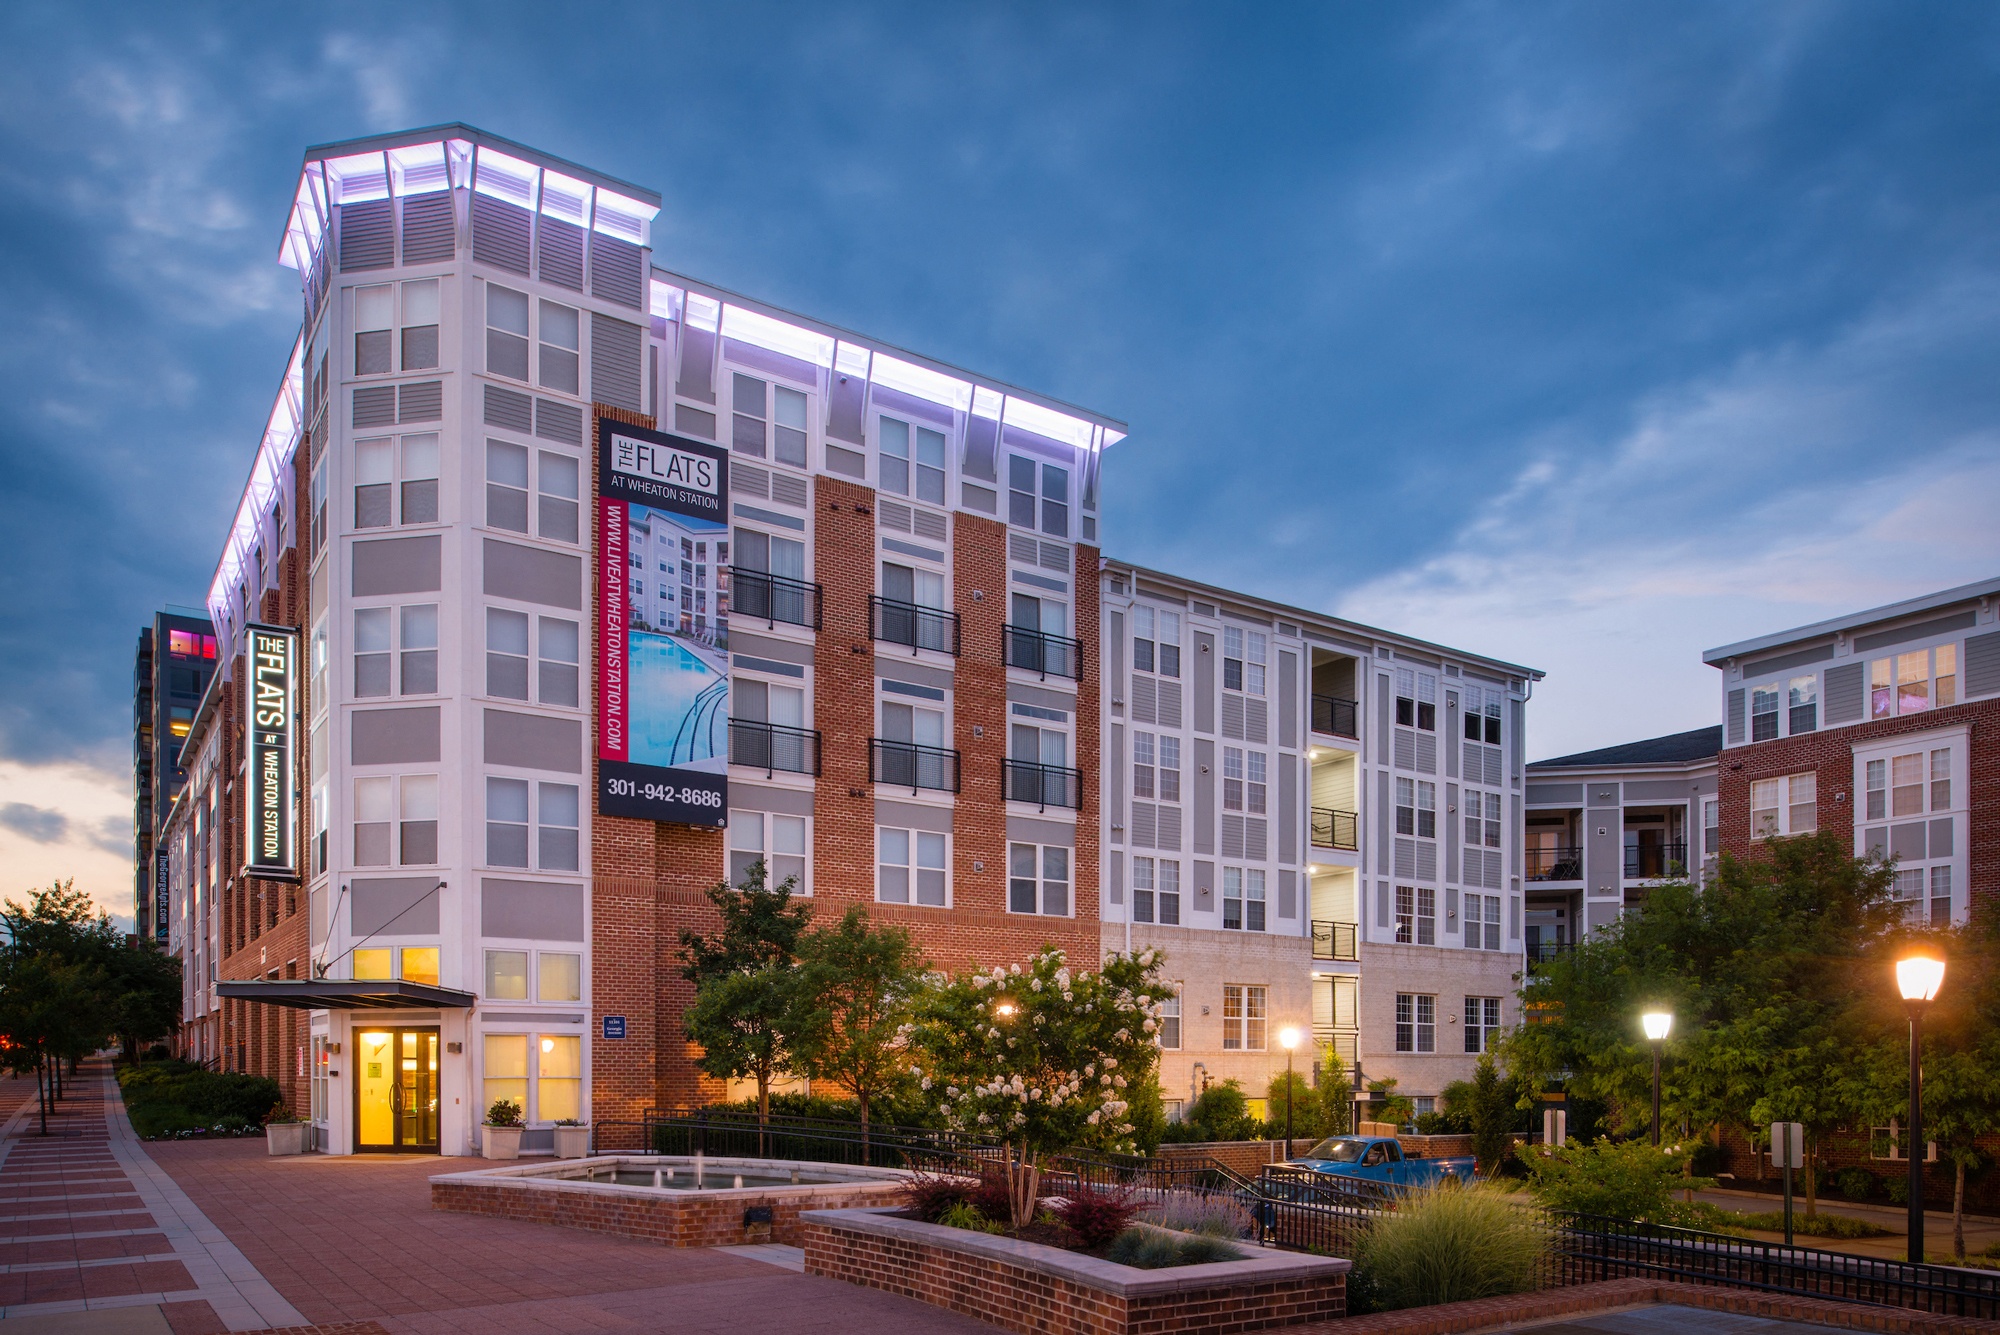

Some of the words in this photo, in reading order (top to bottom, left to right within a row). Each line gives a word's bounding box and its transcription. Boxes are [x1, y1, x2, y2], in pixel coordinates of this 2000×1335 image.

[618, 440, 633, 468] THE
[637, 445, 711, 488] FLATS
[611, 475, 625, 488] AT
[627, 478, 677, 500] WHEATON
[679, 490, 719, 510] STATION
[257, 636, 285, 653] THE
[607, 505, 622, 750] WWW.LIVEATWHEATONSTATION.COM
[256, 653, 285, 727] FLATS
[265, 735, 277, 744] AT
[264, 751, 278, 808] WHEATON
[607, 778, 722, 808] 301-942-8686
[264, 810, 279, 858] STATION
[158, 855, 168, 924] TheGeorgeApts.com
